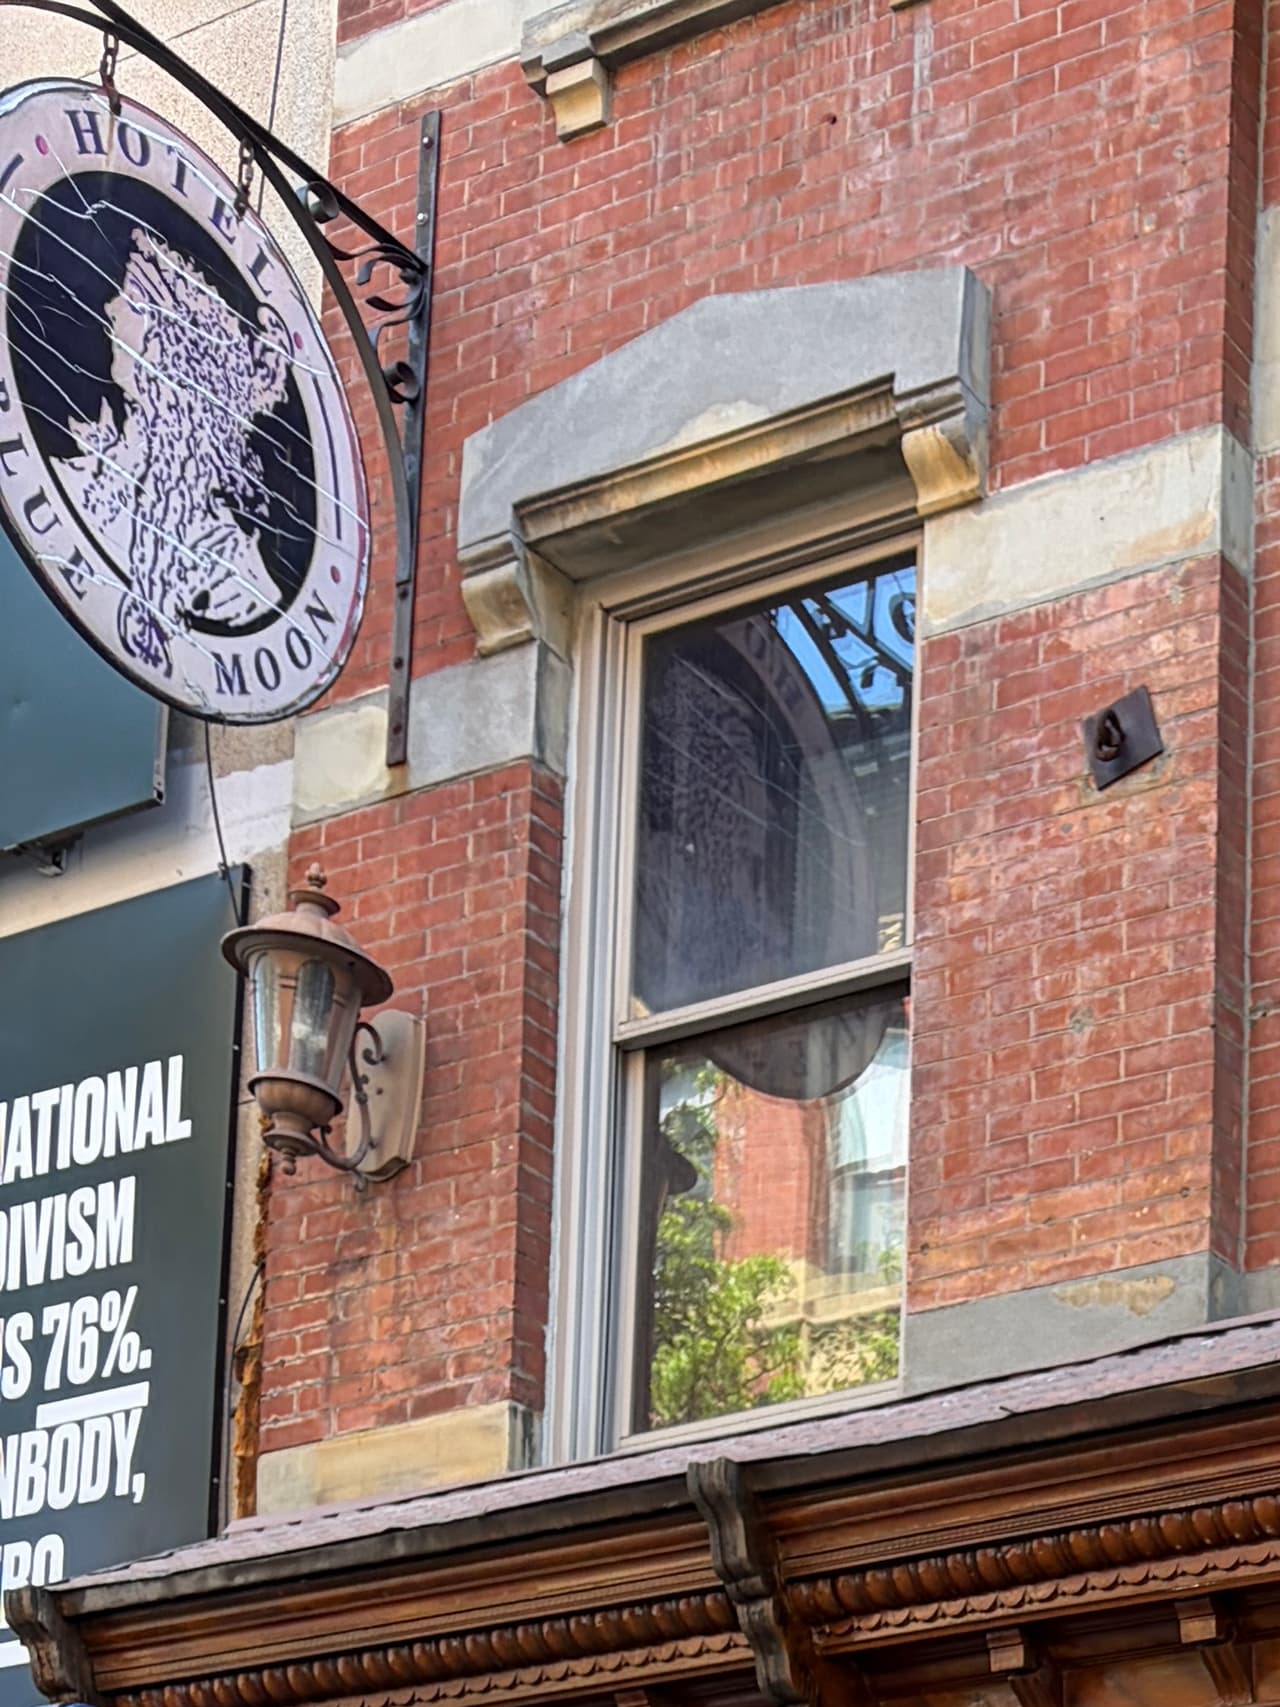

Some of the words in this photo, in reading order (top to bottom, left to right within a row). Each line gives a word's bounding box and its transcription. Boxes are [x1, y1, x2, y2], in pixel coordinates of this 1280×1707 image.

[65, 109, 292, 299] HOTEL
[0, 377, 97, 601] LUE
[214, 602, 340, 696] MOON
[0, 1054, 192, 1186] ATIONAL
[0, 1311, 34, 1400] S
[40, 1285, 152, 1392] 76%.
